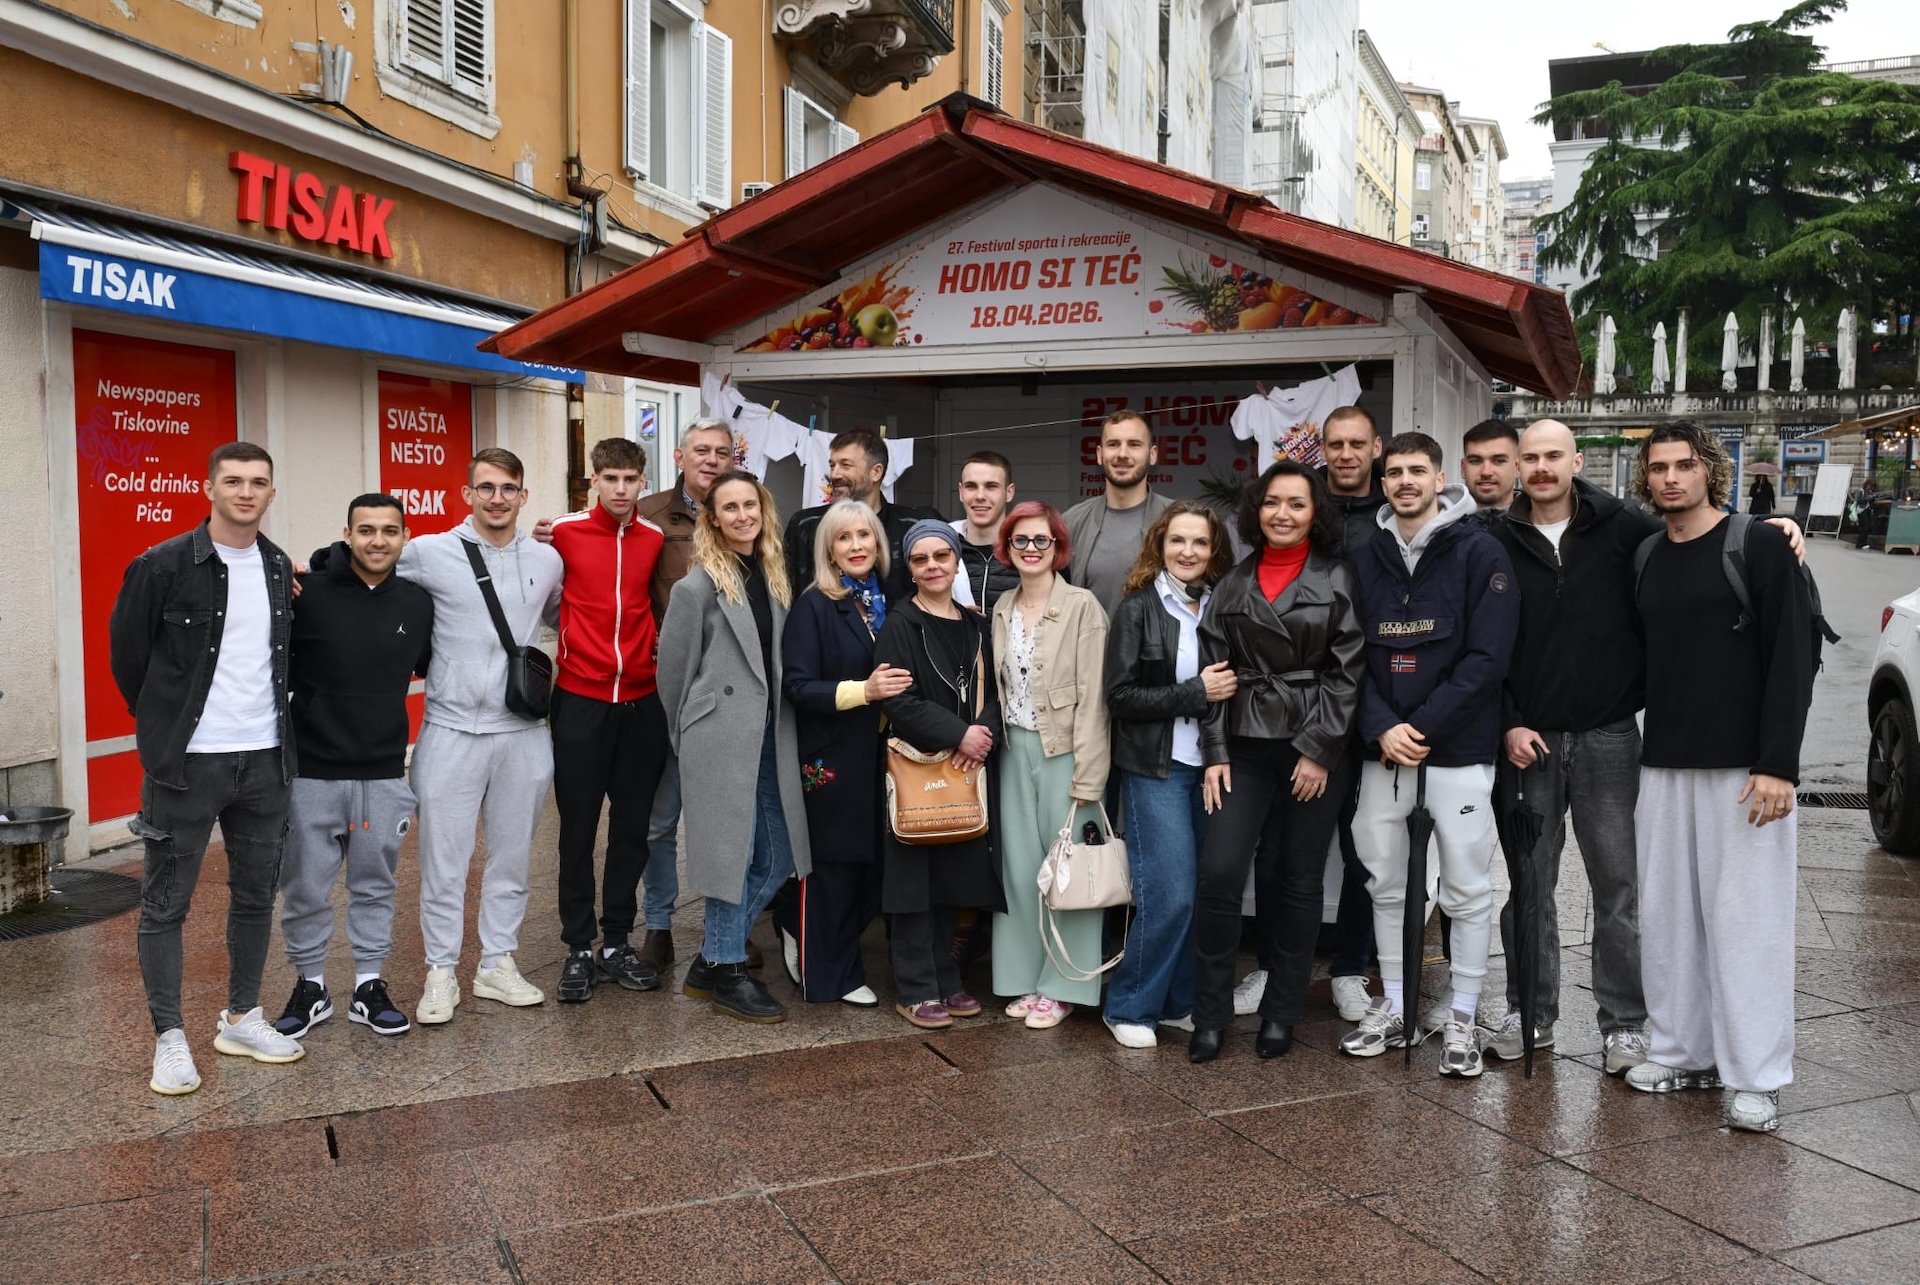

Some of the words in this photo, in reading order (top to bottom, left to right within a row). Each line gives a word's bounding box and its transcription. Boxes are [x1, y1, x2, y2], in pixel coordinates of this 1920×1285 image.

[229, 151, 395, 259] TISAK
[947, 241, 964, 255] 27.
[967, 237, 1015, 254] Festival
[1018, 236, 1058, 252] sporta
[1061, 234, 1066, 247] i
[1068, 231, 1131, 248] rekreacije
[66, 254, 177, 310] TISAK
[938, 260, 1032, 294] HOMO
[1038, 257, 1076, 289] SI
[1083, 246, 1142, 286] TEĆ
[970, 300, 1103, 328] 18.04.2026.
[97, 378, 201, 408] Newspapers
[111, 409, 190, 436] Tiskovine
[386, 406, 448, 434] SVAŠTA
[1144, 395, 1239, 426] HOM
[390, 438, 445, 466] NEŠTO
[104, 471, 146, 493] Cold
[149, 472, 200, 494] drinks
[136, 501, 173, 523] Pića
[389, 488, 446, 516] TISAK
